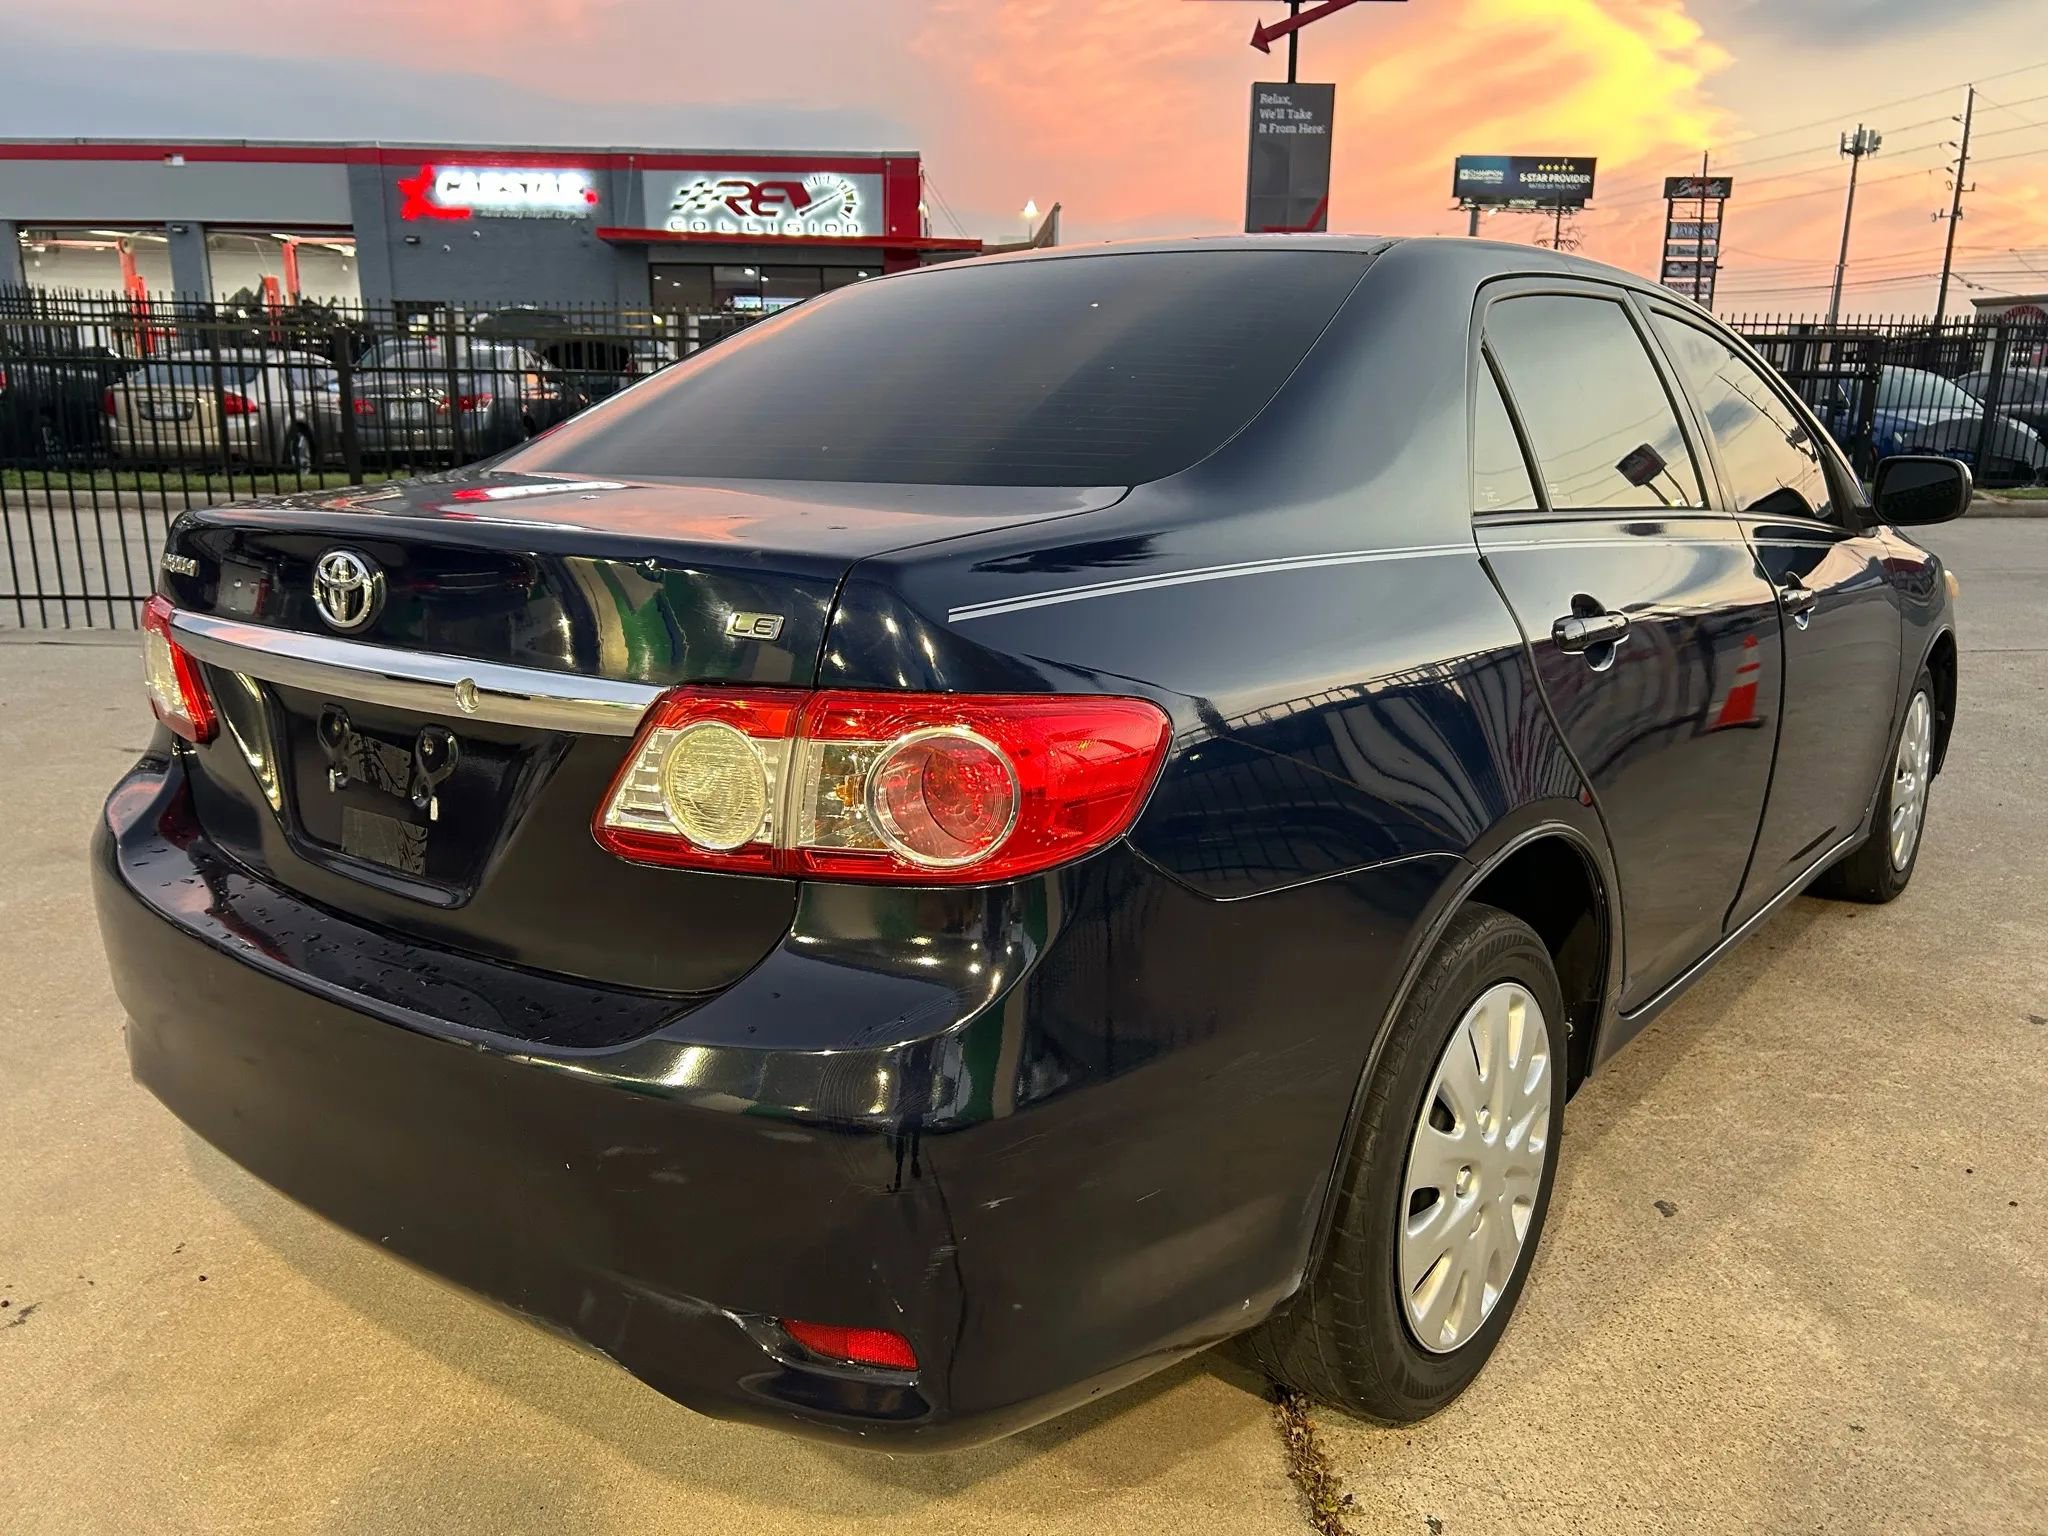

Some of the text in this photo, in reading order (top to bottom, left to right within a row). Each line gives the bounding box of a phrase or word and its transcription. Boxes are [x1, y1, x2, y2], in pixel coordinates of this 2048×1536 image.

[1260, 93, 1292, 105] Relax,
[1259, 108, 1312, 119] We'll Take
[1258, 122, 1267, 134] It
[1269, 122, 1297, 134] From
[1549, 173, 1592, 184] PROVIDER
[670, 220, 859, 234] COLLISION
[730, 613, 780, 638] LE
